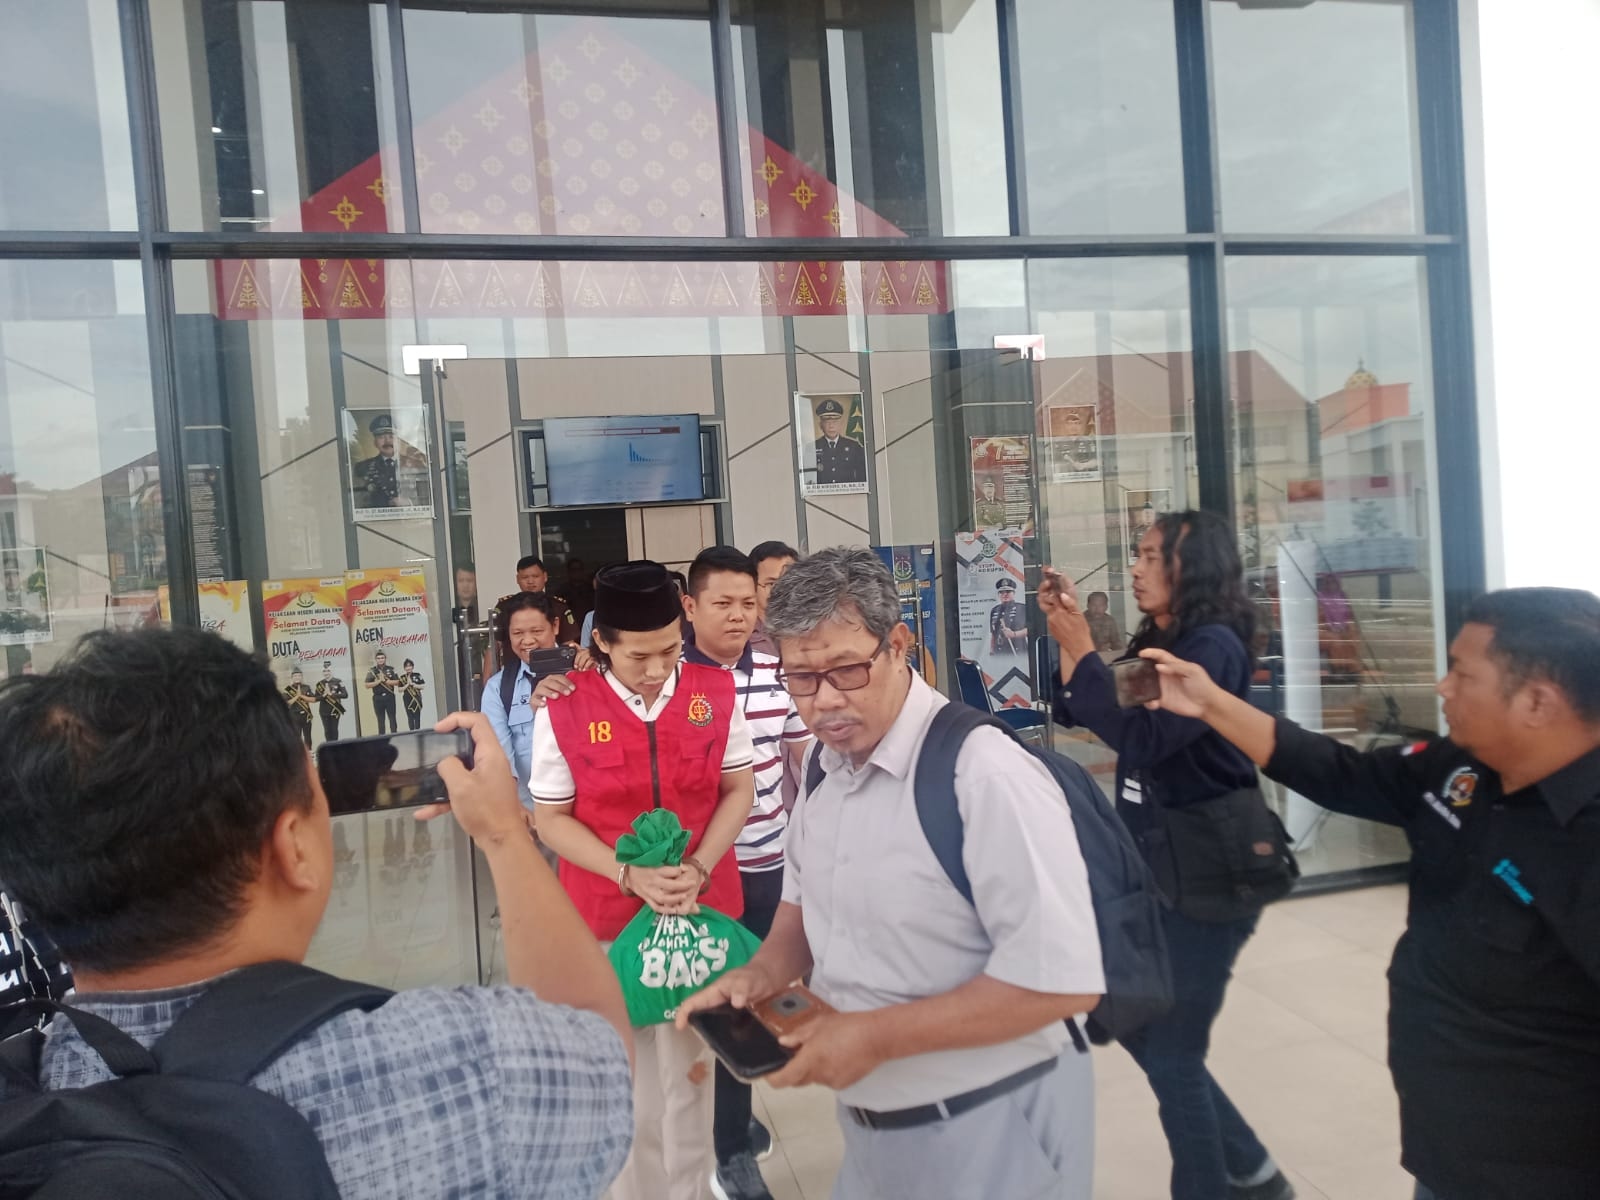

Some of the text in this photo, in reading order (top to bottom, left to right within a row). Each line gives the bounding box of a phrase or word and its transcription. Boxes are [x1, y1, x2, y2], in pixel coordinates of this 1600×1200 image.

[357, 608, 390, 617] Selamat
[392, 606, 421, 614] Datang
[273, 618, 341, 629] Selamat Datang
[355, 627, 384, 643] AGEN
[271, 640, 300, 657] DUTA
[588, 720, 613, 744] 18
[639, 935, 729, 990] BAGS
